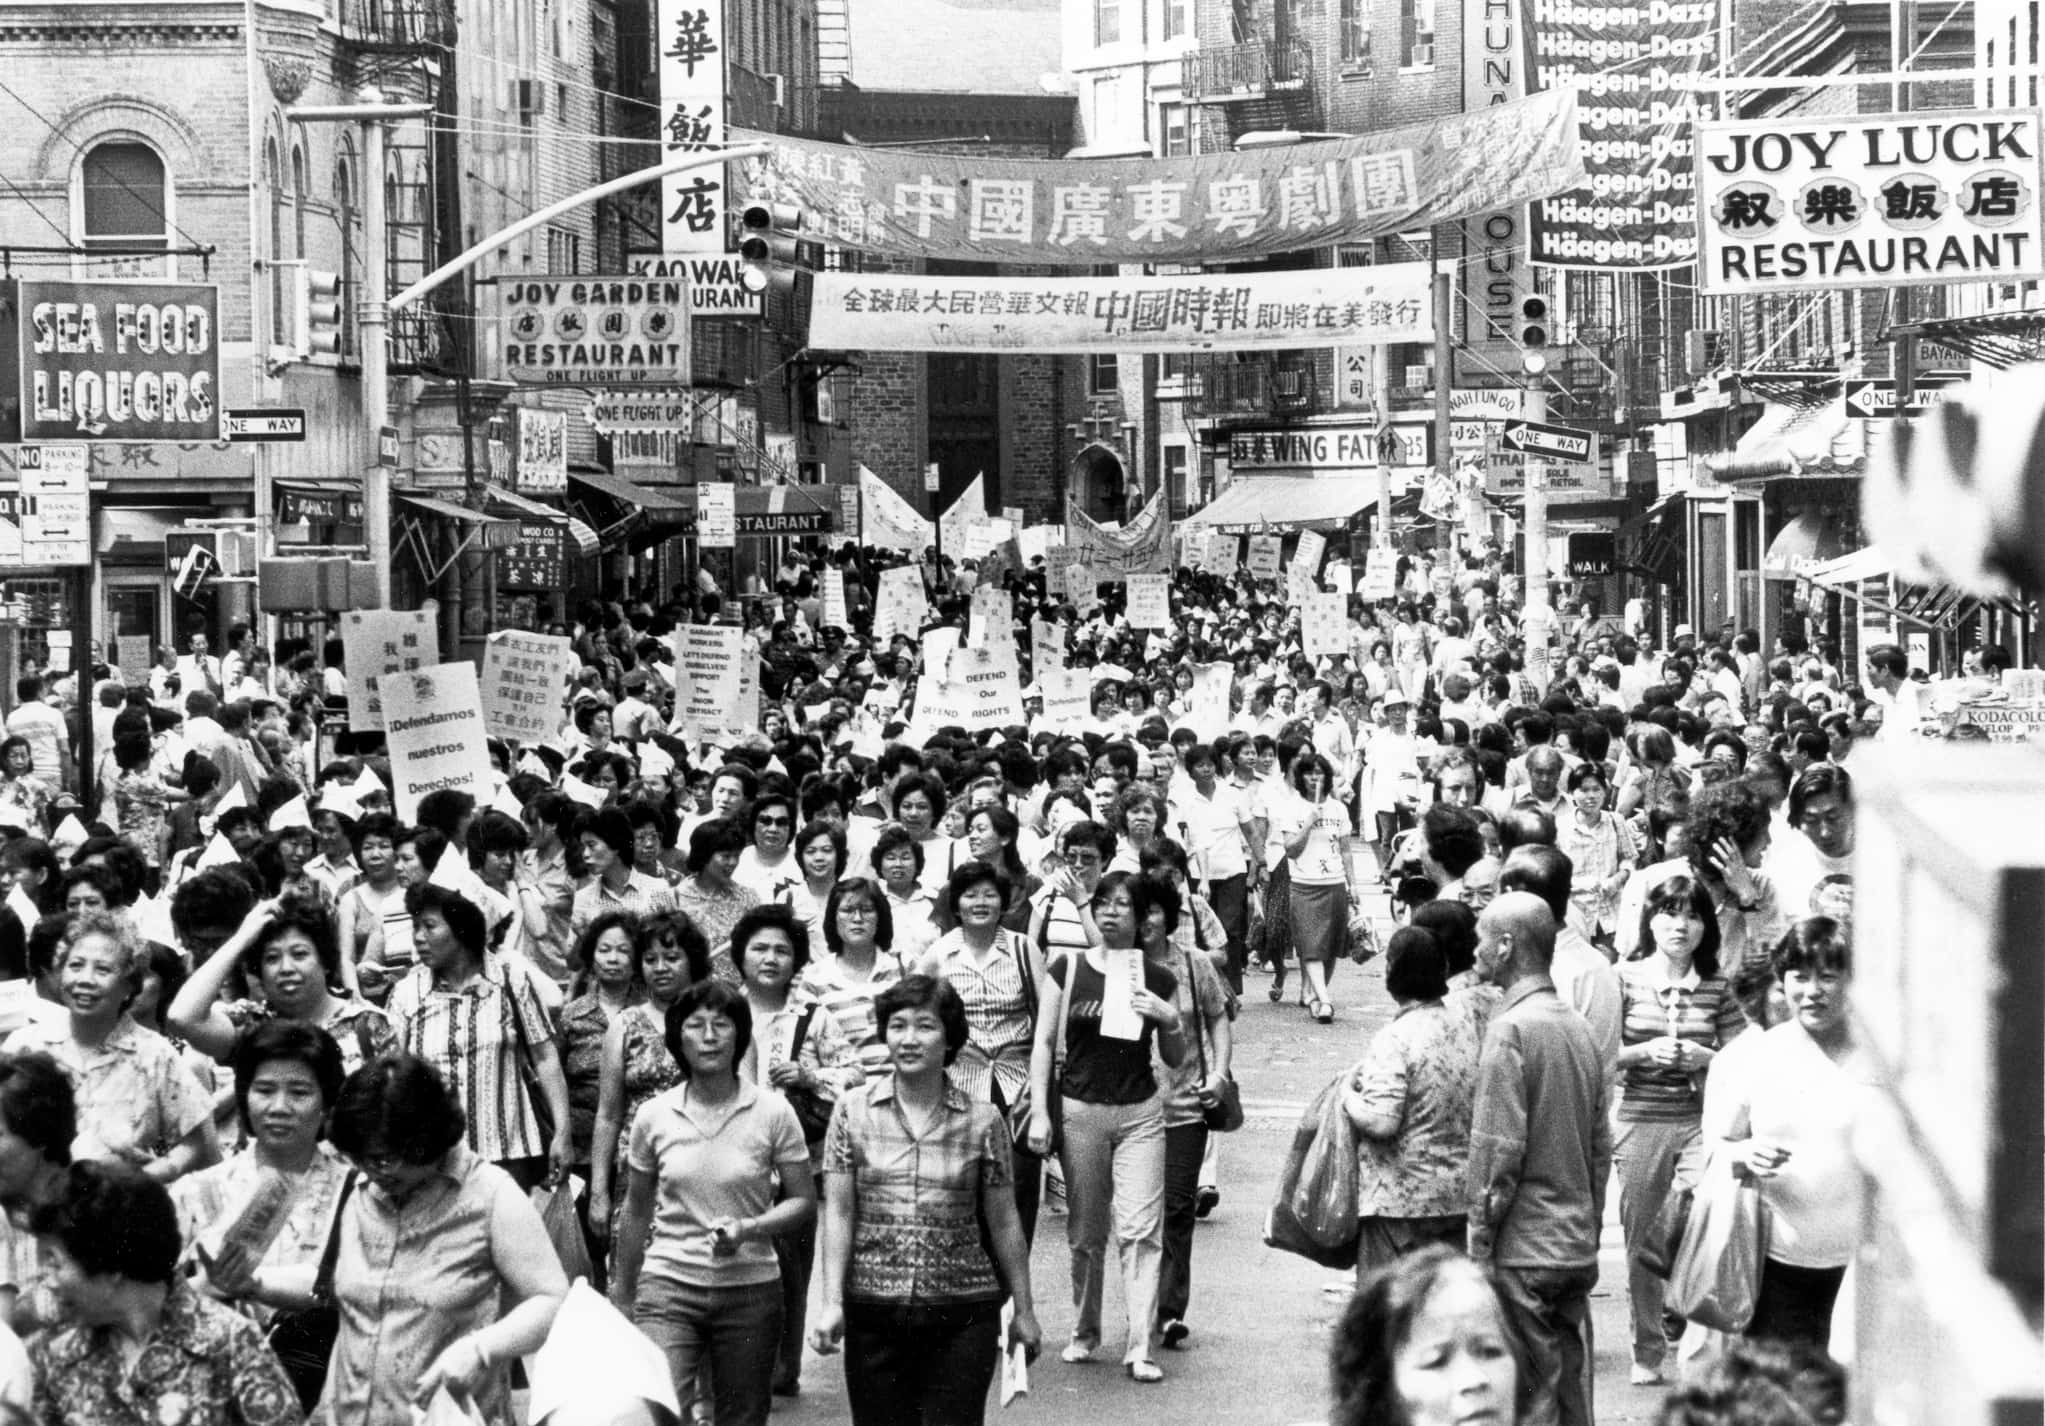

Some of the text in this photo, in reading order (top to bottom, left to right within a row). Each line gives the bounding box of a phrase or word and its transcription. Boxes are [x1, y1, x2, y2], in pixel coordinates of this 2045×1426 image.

[1537, 31, 1714, 64] Häagen-Dazs
[663, 9, 721, 232] 華飯店
[1577, 101, 1712, 130] agen-Das
[1578, 135, 1693, 164] agen-Daz
[1707, 121, 2033, 174] JOY LUCK
[1542, 198, 1697, 230] Häagen-Daz
[1543, 231, 1697, 263] Häagen-Daz
[1721, 232, 2030, 281] RESTAURANT
[1486, 215, 1514, 339] OUSE
[507, 283, 680, 306] JOY GARDEN
[692, 288, 758, 308] URANT
[33, 302, 210, 354] SEA FOOD
[506, 344, 680, 365] RESTAURANT
[546, 370, 648, 381] ONE FLIGHT UP
[33, 370, 212, 434] LIQUORS
[1919, 391, 1942, 406] WA
[595, 405, 683, 421] ONE FLIGHT UP
[267, 418, 297, 432] WAY
[1272, 435, 1328, 462] WING
[1338, 434, 1374, 461] FAT
[1515, 429, 1583, 451] ONE WAY
[20, 448, 40, 467] NO
[734, 515, 822, 531] STAURANT
[1572, 561, 1610, 574] WALK
[966, 671, 1007, 683] DEFEND
[979, 689, 997, 698] Our
[971, 706, 1011, 718] RIGHTS
[407, 741, 465, 761] nuestros
